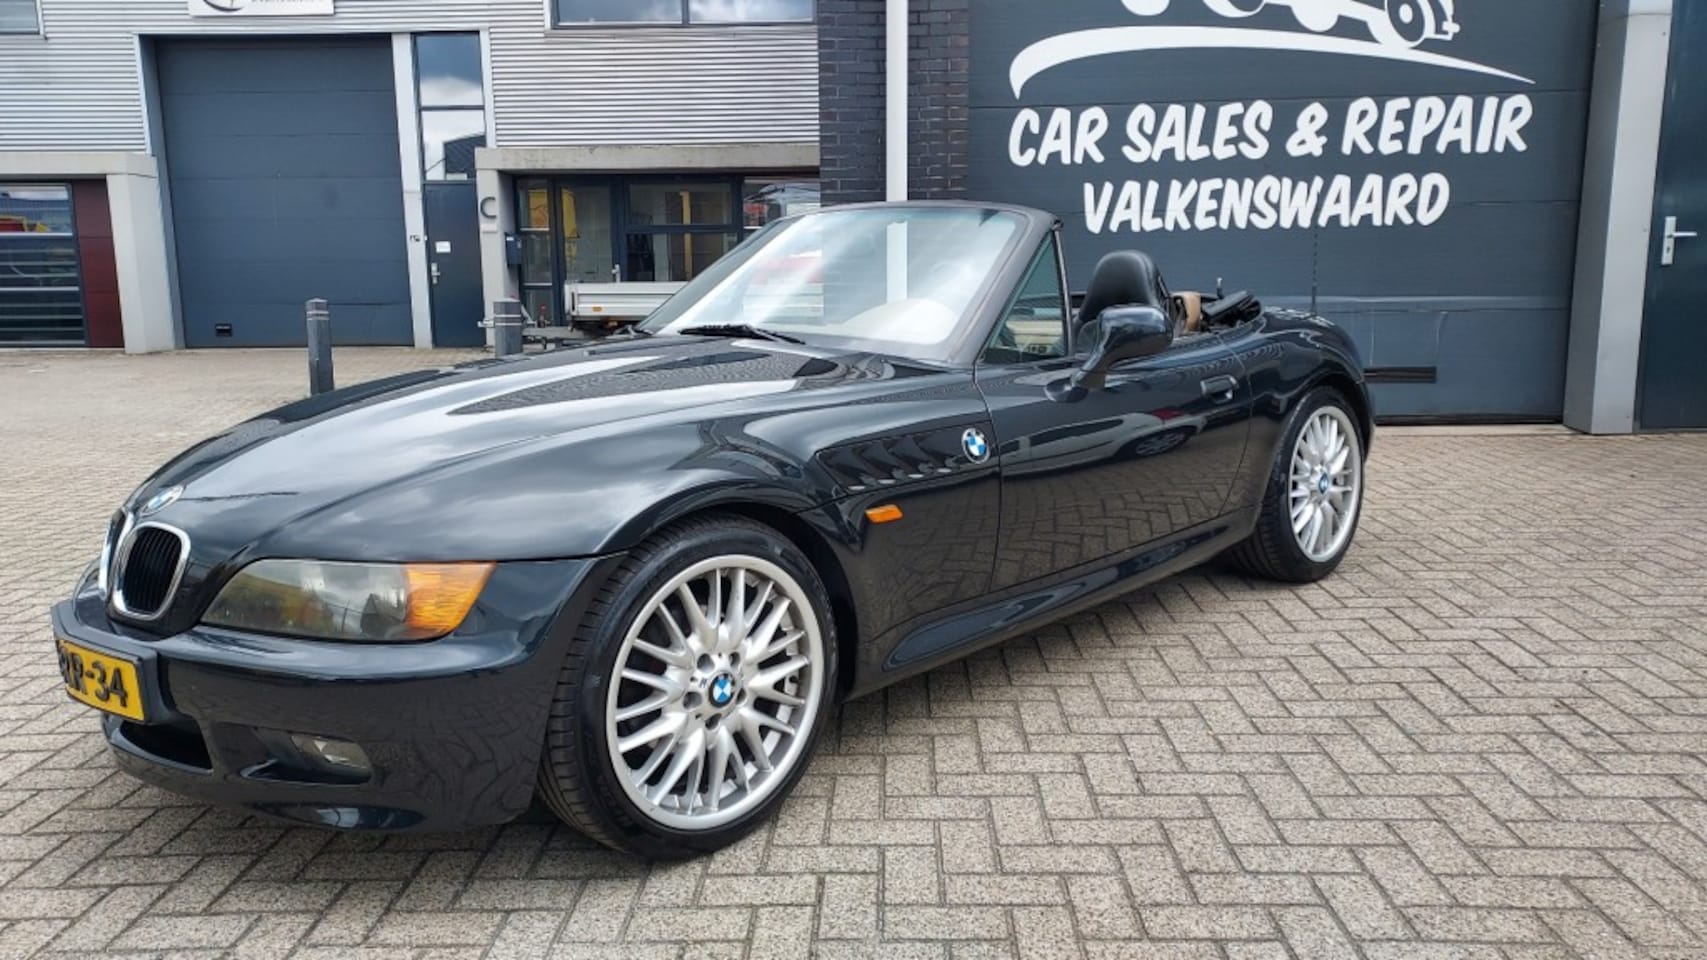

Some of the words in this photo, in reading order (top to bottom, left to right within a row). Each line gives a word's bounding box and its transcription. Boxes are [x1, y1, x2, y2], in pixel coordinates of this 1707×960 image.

[1009, 106, 1108, 167] CAR
[1122, 100, 1272, 164] SALES
[1286, 102, 1328, 157] &
[1342, 94, 1533, 157] REPAIR
[1084, 173, 1450, 234] VALKENSWAARD
